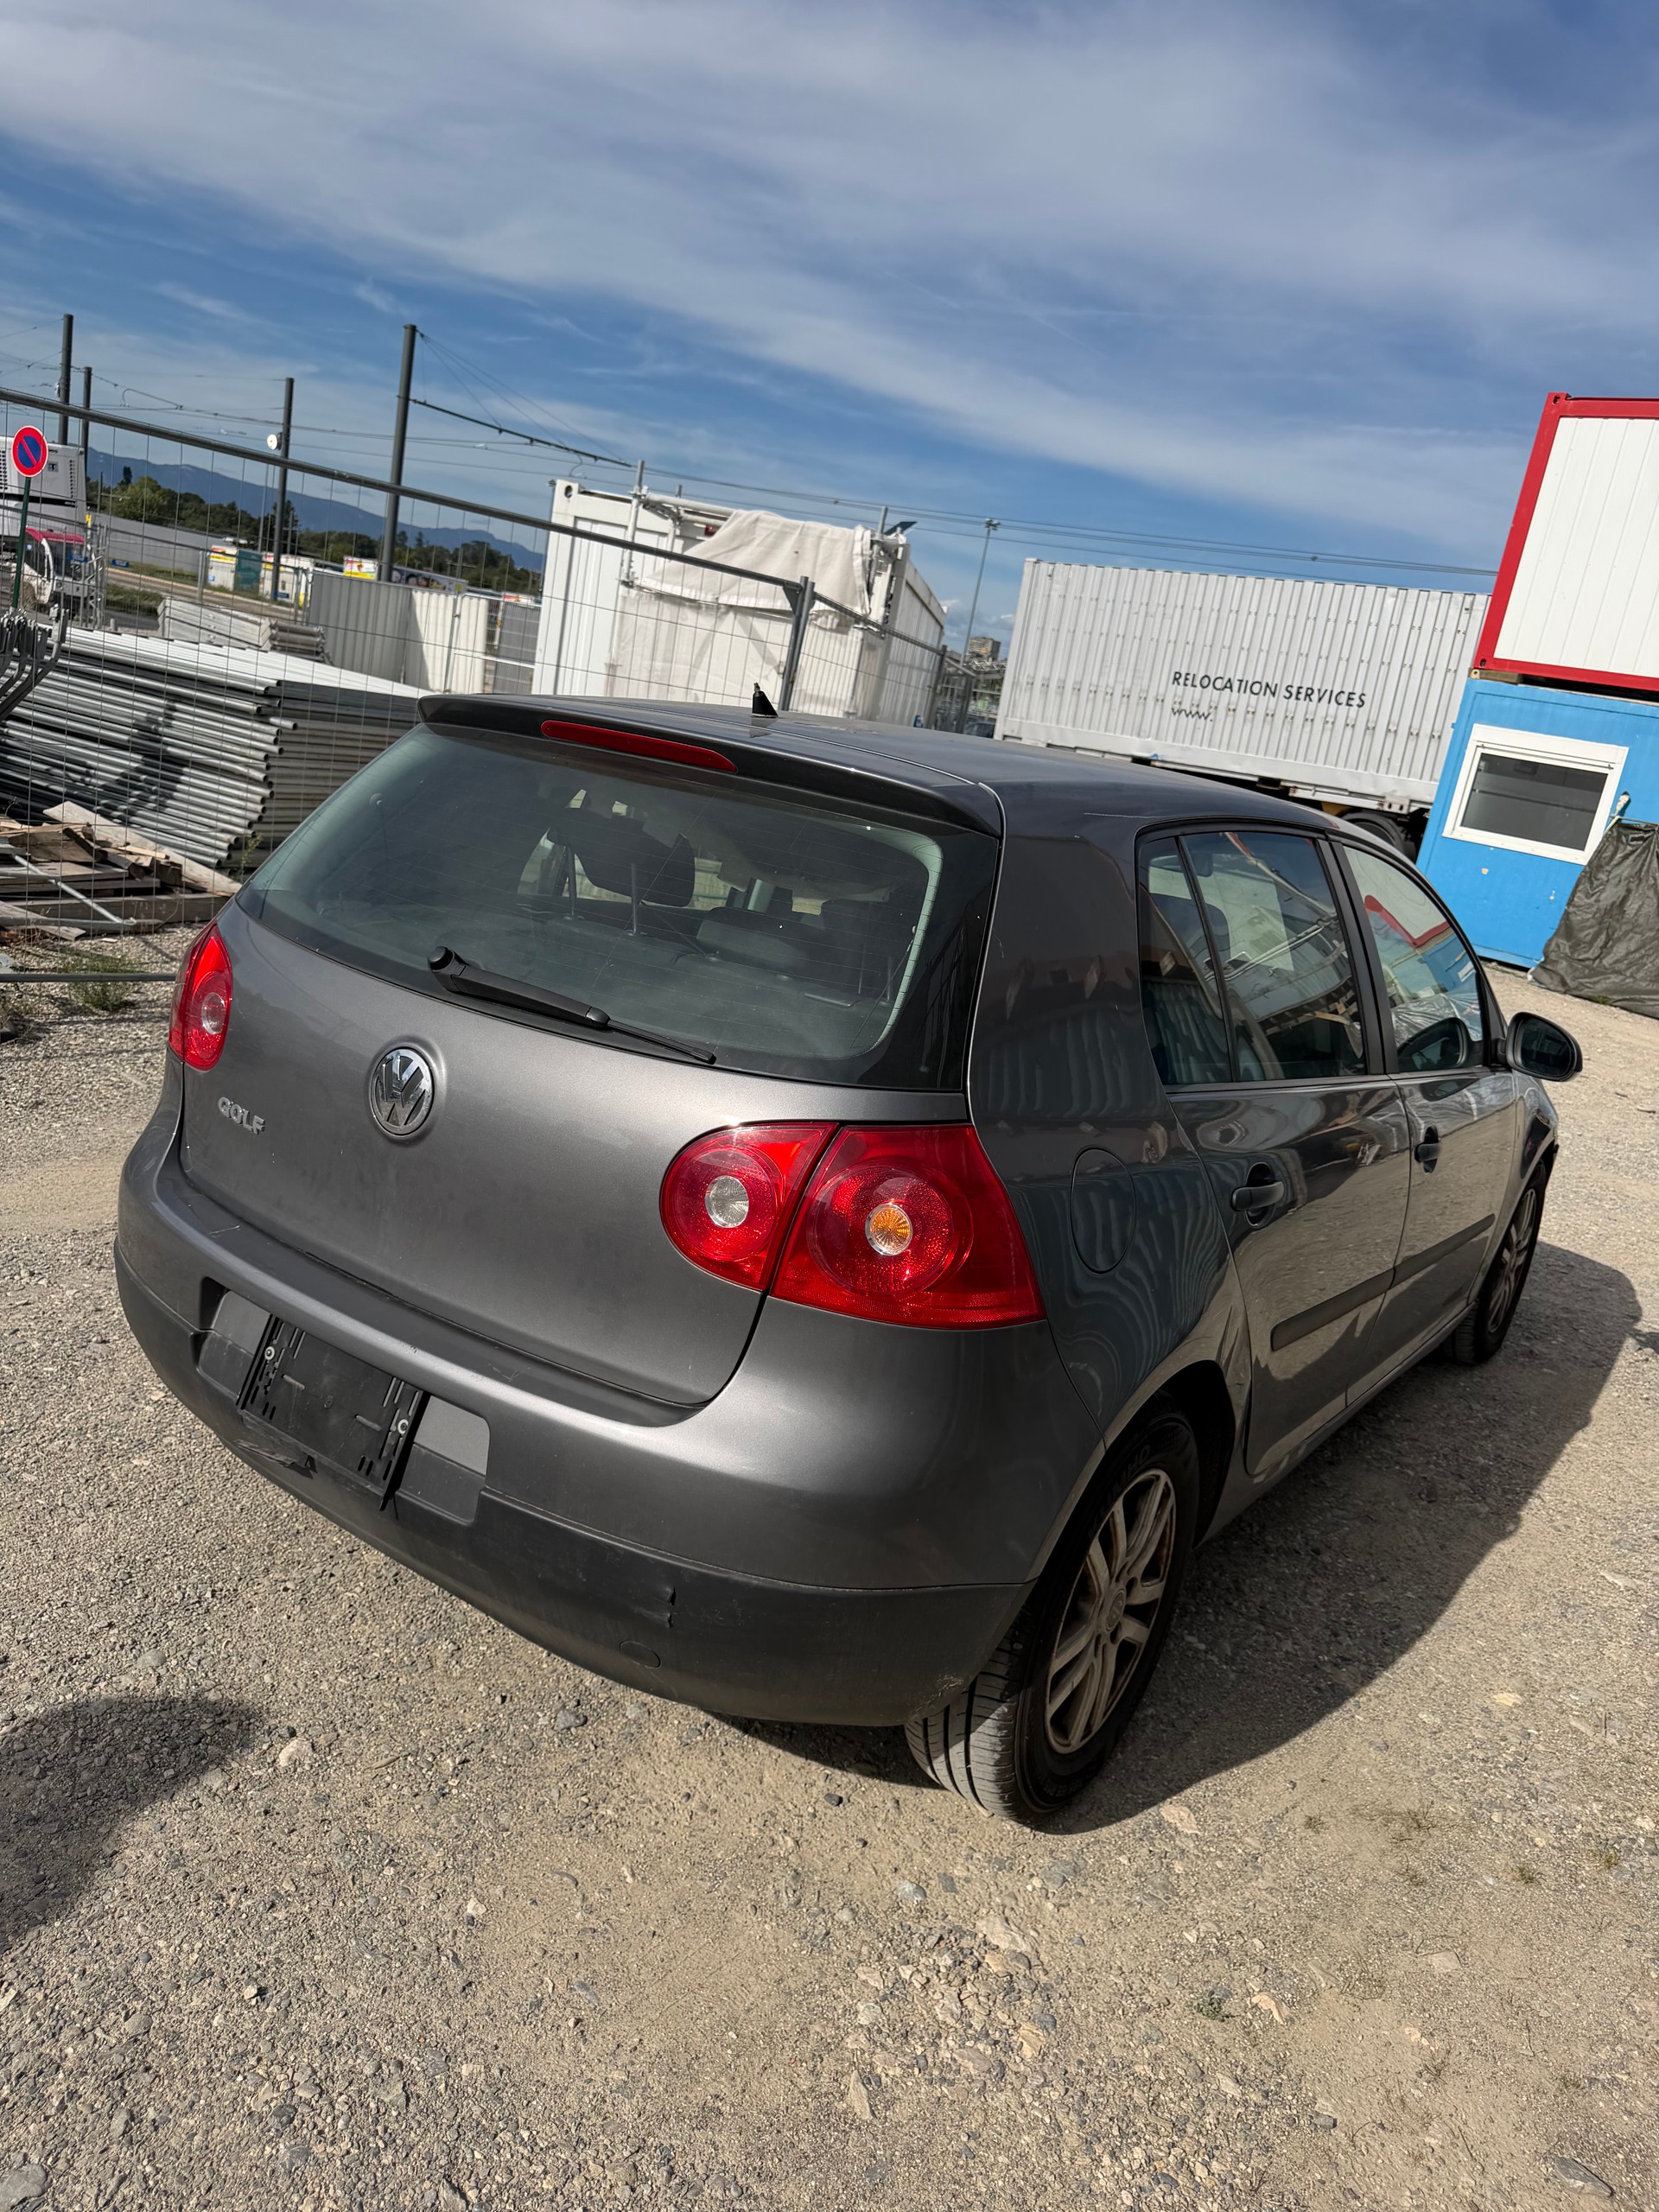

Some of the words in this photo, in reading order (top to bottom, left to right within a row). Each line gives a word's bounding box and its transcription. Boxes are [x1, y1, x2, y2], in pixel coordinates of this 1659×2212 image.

[1172, 671, 1278, 698] RELOCATION
[1283, 684, 1366, 709] SERVICES
[218, 1096, 265, 1135] GOLF
